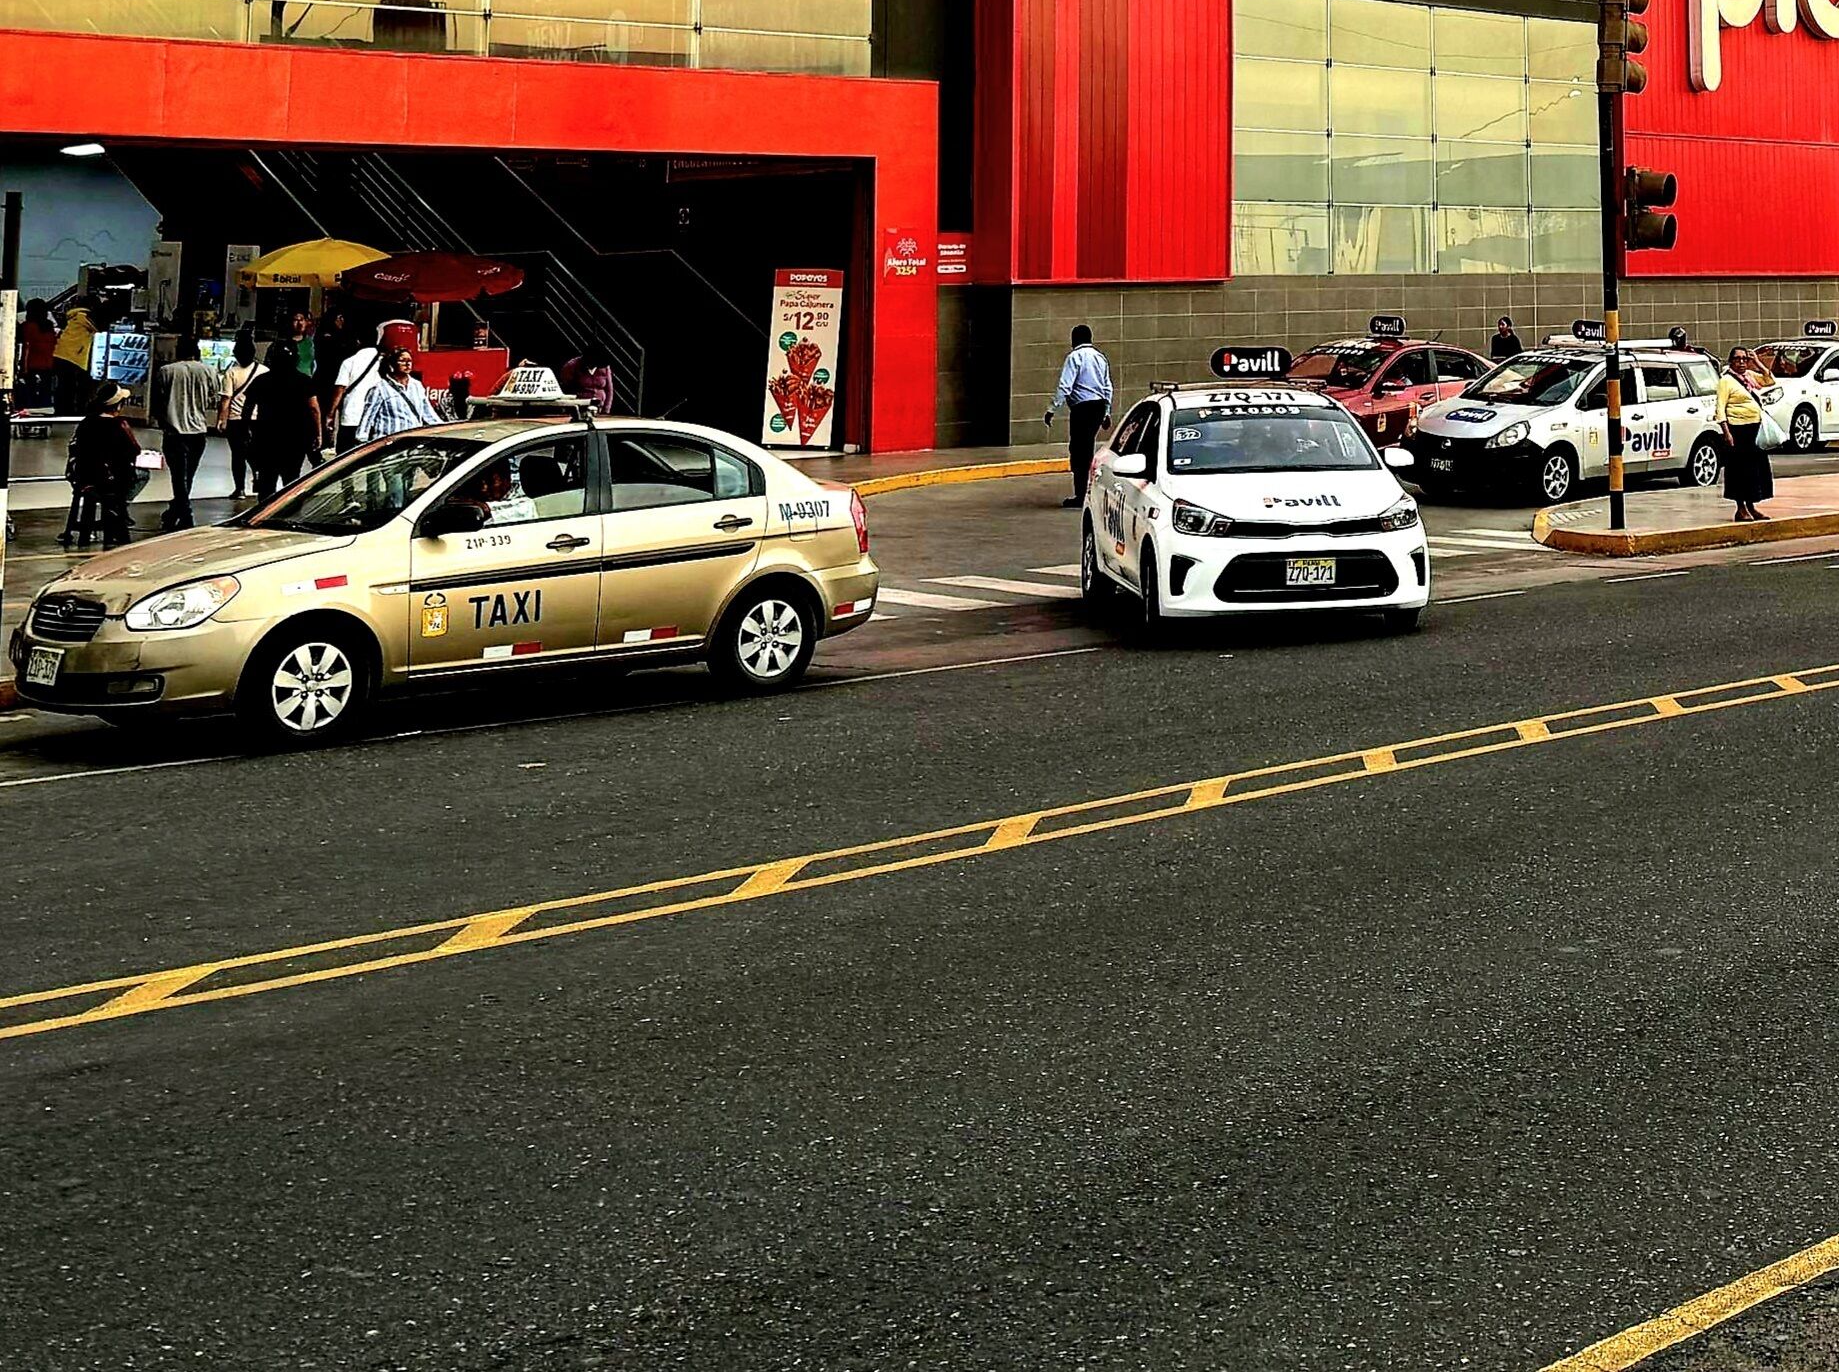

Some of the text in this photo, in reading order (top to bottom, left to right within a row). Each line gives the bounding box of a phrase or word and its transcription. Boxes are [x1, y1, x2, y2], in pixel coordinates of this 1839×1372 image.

[779, 299, 800, 309] Papa
[1223, 351, 1281, 372] Pavill
[518, 369, 545, 383] TAXI
[468, 588, 543, 630] TAXI
